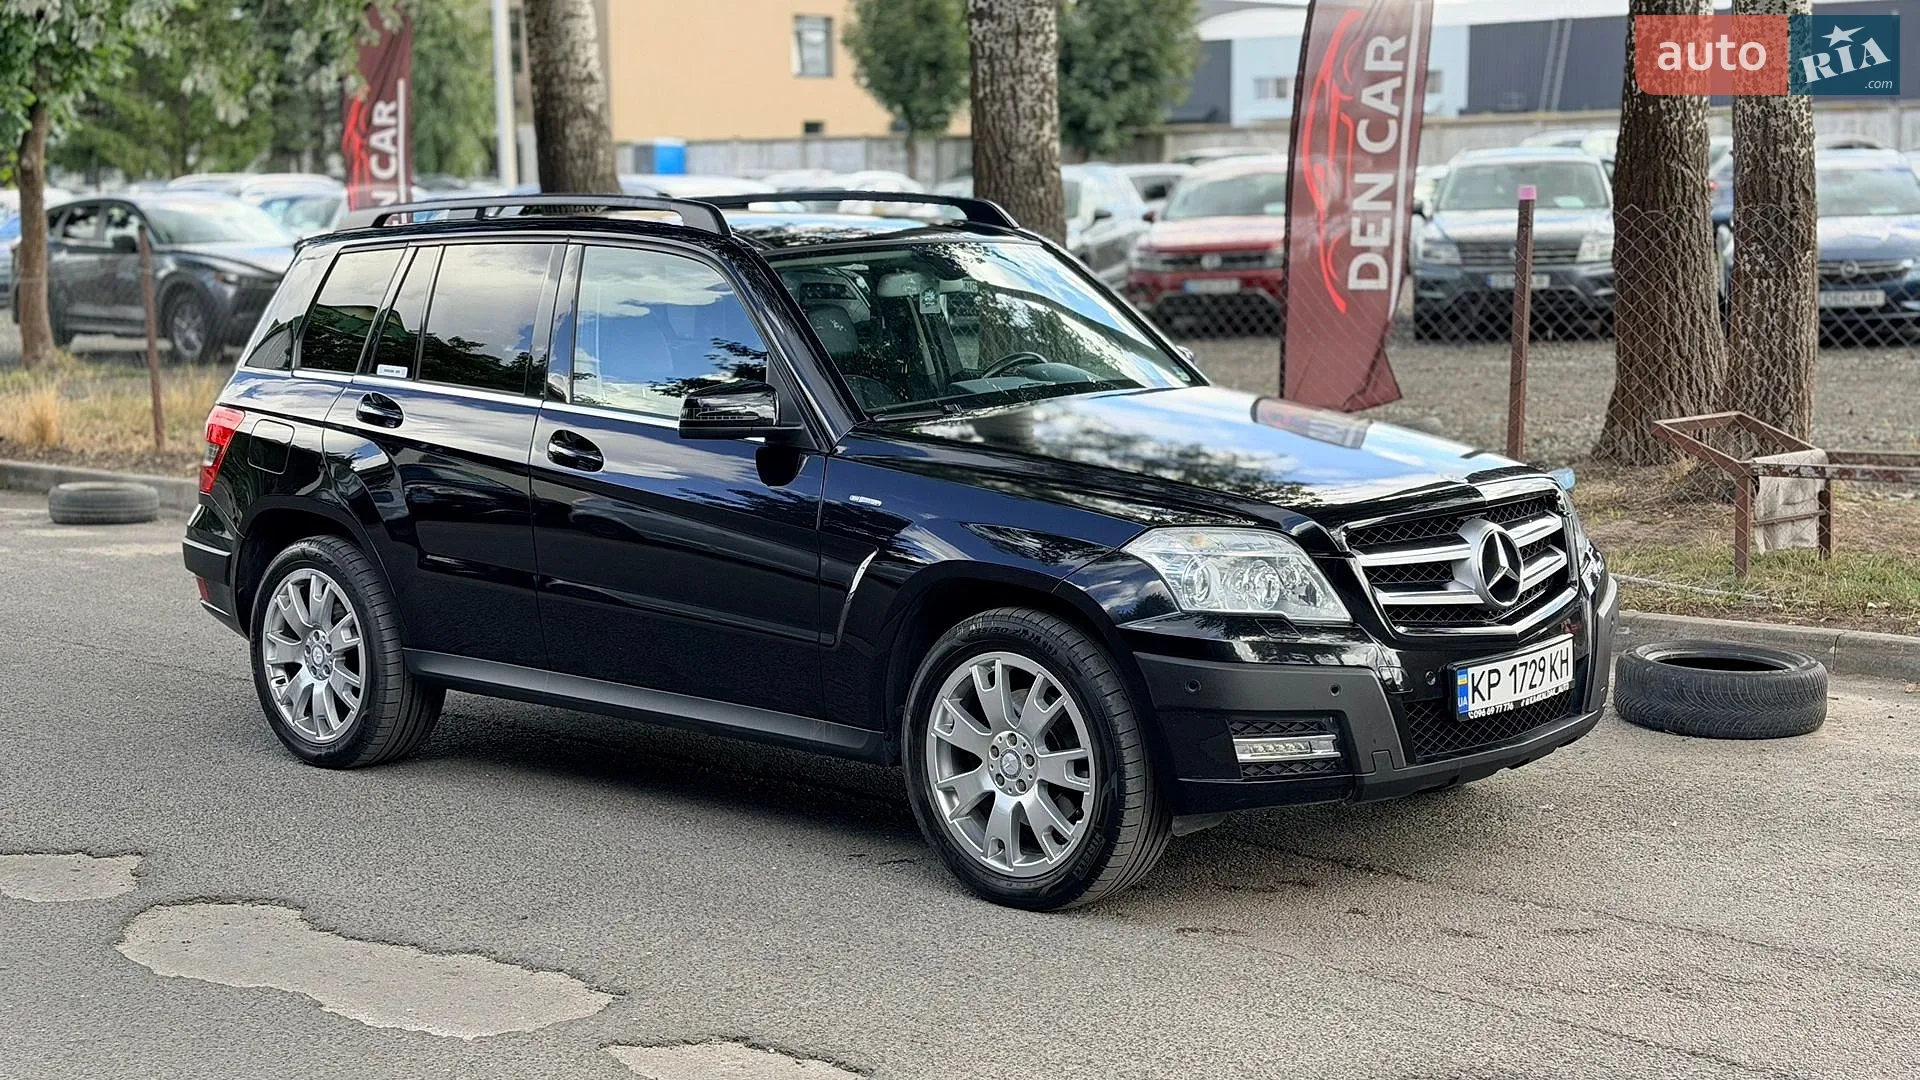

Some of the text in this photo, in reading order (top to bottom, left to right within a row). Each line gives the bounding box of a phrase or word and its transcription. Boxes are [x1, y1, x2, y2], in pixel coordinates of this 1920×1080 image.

[369, 100, 397, 180] CAR
[1348, 35, 1407, 291] DEN CAR
[1457, 696, 1468, 708] UA
[1471, 647, 1569, 705] KP 1729 KH
